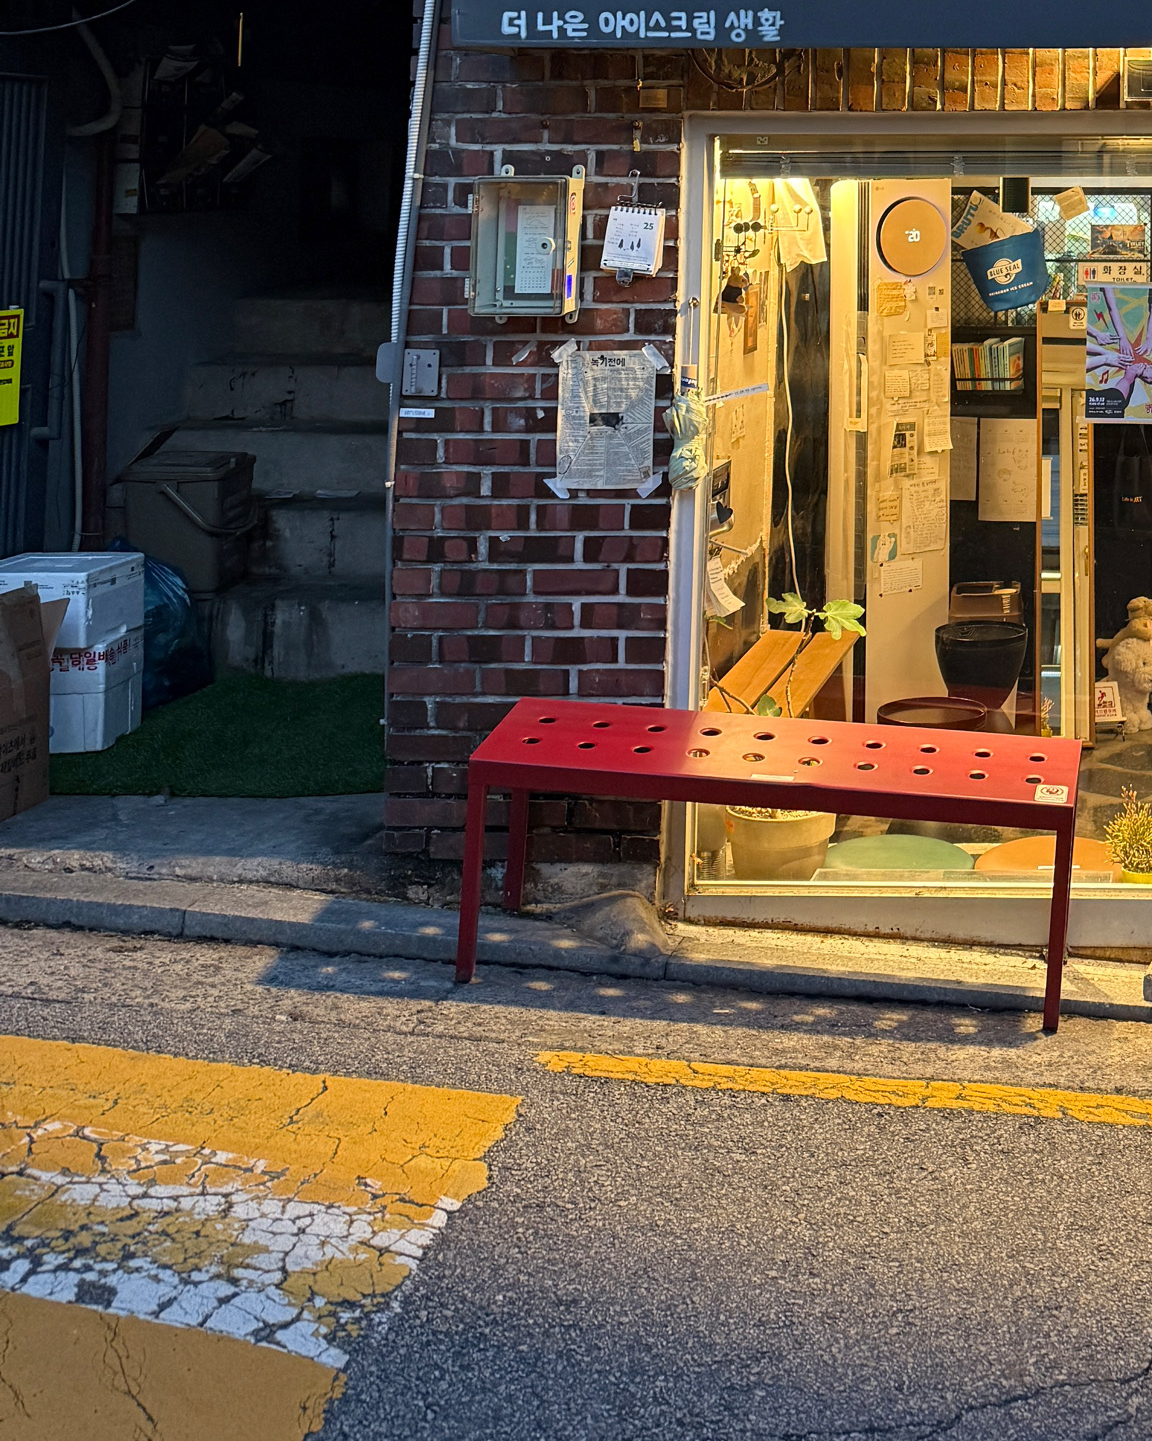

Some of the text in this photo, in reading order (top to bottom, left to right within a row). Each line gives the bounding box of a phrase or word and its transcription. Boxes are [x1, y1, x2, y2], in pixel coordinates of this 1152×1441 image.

[501, 8, 785, 43] 더 나은 아이스크림 생활
[643, 222, 655, 231] 25
[988, 262, 1021, 279] BLUE SEAL
